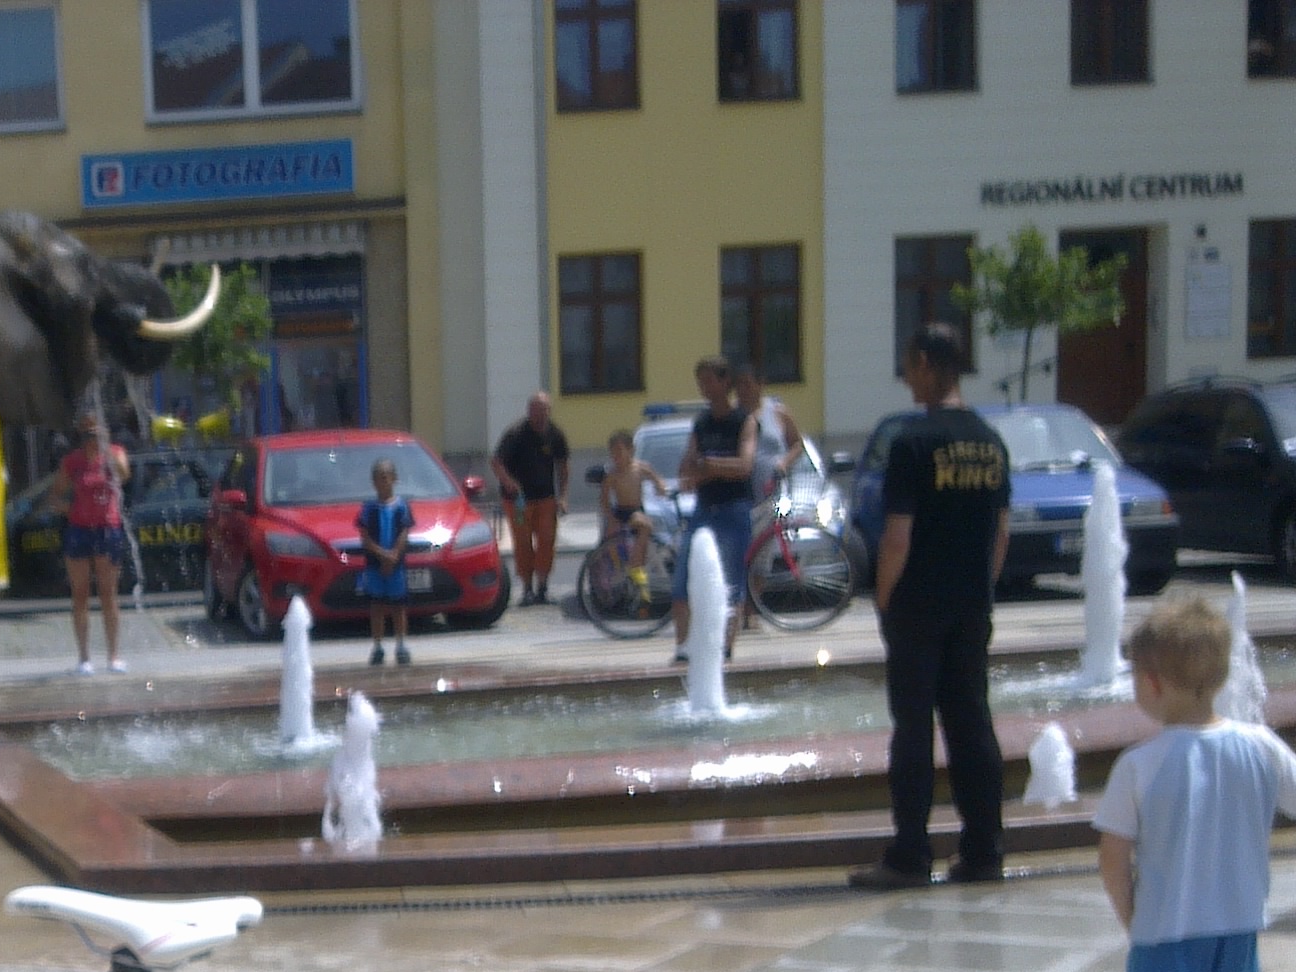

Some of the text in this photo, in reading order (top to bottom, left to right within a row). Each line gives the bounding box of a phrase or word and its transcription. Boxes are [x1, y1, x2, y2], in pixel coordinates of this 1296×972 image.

[132, 153, 341, 190] FOTOGRAFIA
[980, 172, 1244, 204] REGIONÁLNÍ CENTRUM
[935, 466, 1002, 490] KING
[139, 523, 202, 546] KING
